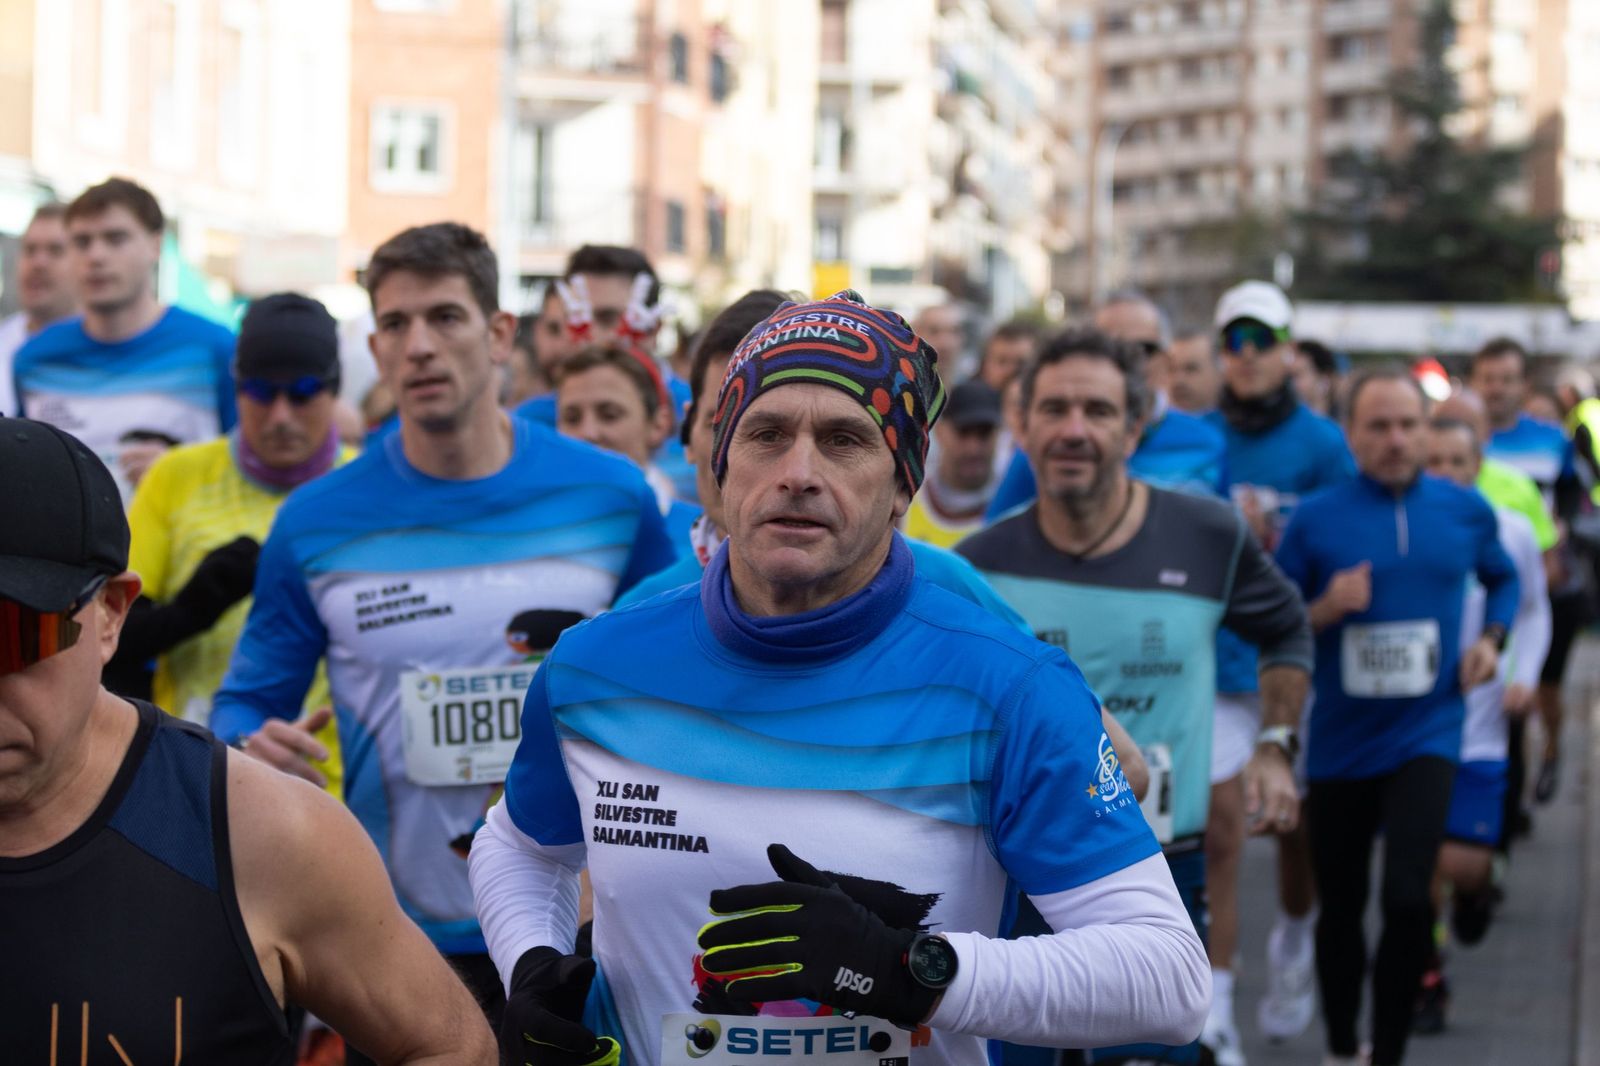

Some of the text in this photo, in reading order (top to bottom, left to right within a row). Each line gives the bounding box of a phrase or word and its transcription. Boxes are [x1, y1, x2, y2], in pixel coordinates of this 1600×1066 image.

[356, 594, 427, 617] SILVESTRE
[357, 605, 453, 634] SALMANTINA
[446, 672, 532, 695] SETE
[431, 698, 520, 747] 1080
[621, 783, 660, 801] SAN
[594, 803, 678, 827] SILVESTRE
[592, 825, 710, 854] SALMANTINA
